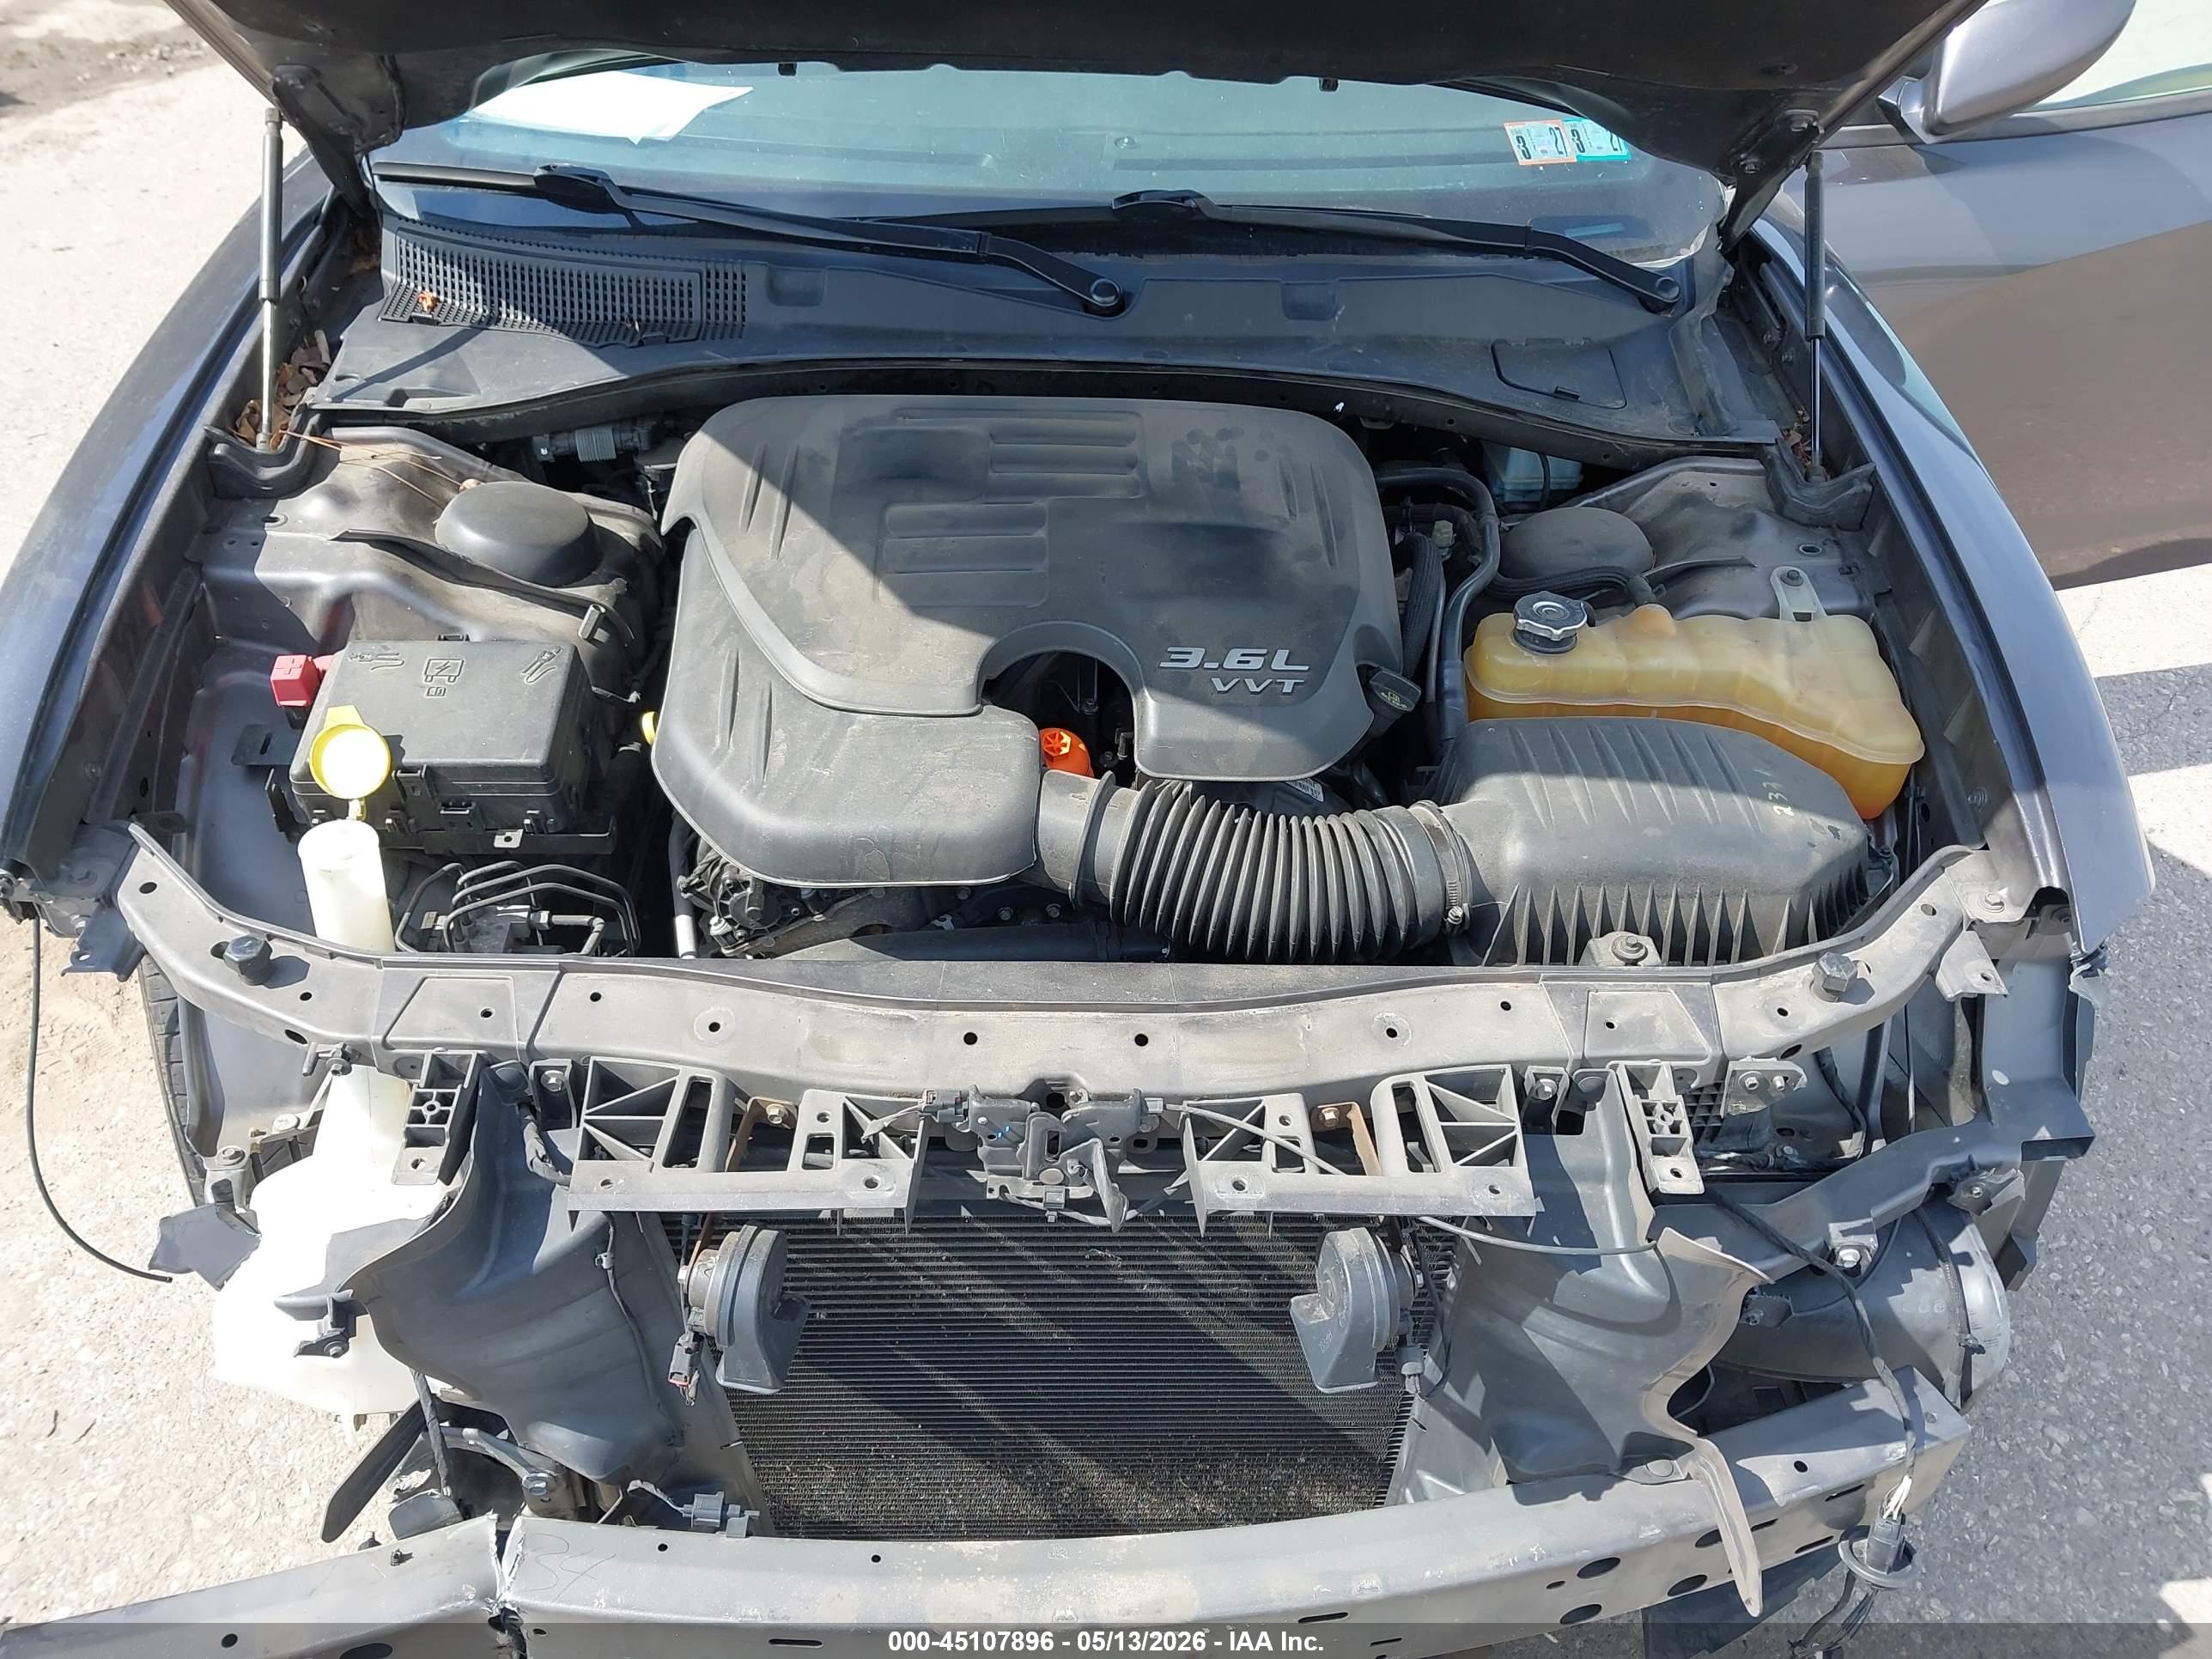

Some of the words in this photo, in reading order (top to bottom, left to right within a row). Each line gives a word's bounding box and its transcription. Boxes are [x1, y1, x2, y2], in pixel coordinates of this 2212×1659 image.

[1516, 135, 1532, 160] 3
[1548, 126, 1568, 157] 27
[1571, 129, 1586, 154] 3
[1159, 647, 1310, 672] 3.6L
[1211, 678, 1305, 695] VVT
